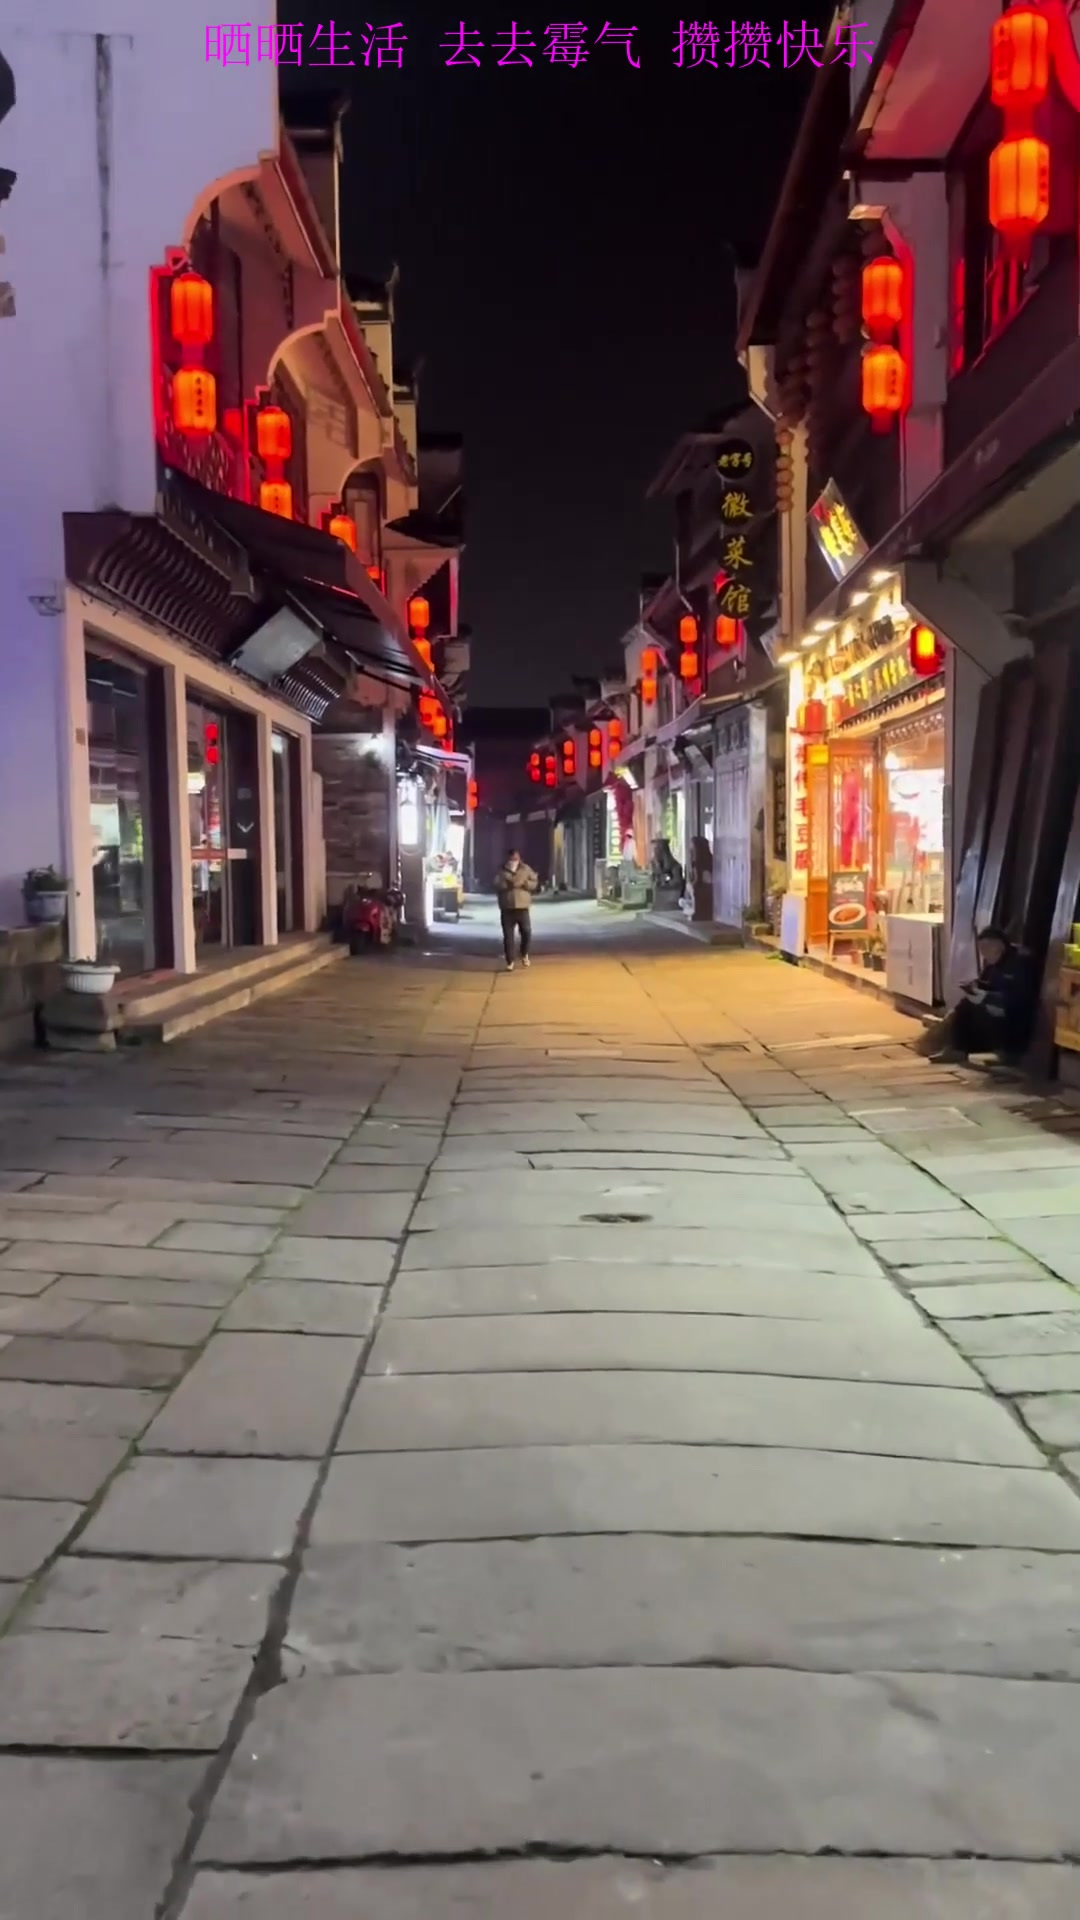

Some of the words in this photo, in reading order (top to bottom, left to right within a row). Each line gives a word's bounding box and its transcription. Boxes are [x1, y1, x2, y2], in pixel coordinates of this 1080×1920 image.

[718, 452, 753, 468] 老字号
[720, 491, 754, 614] 徽菜馆
